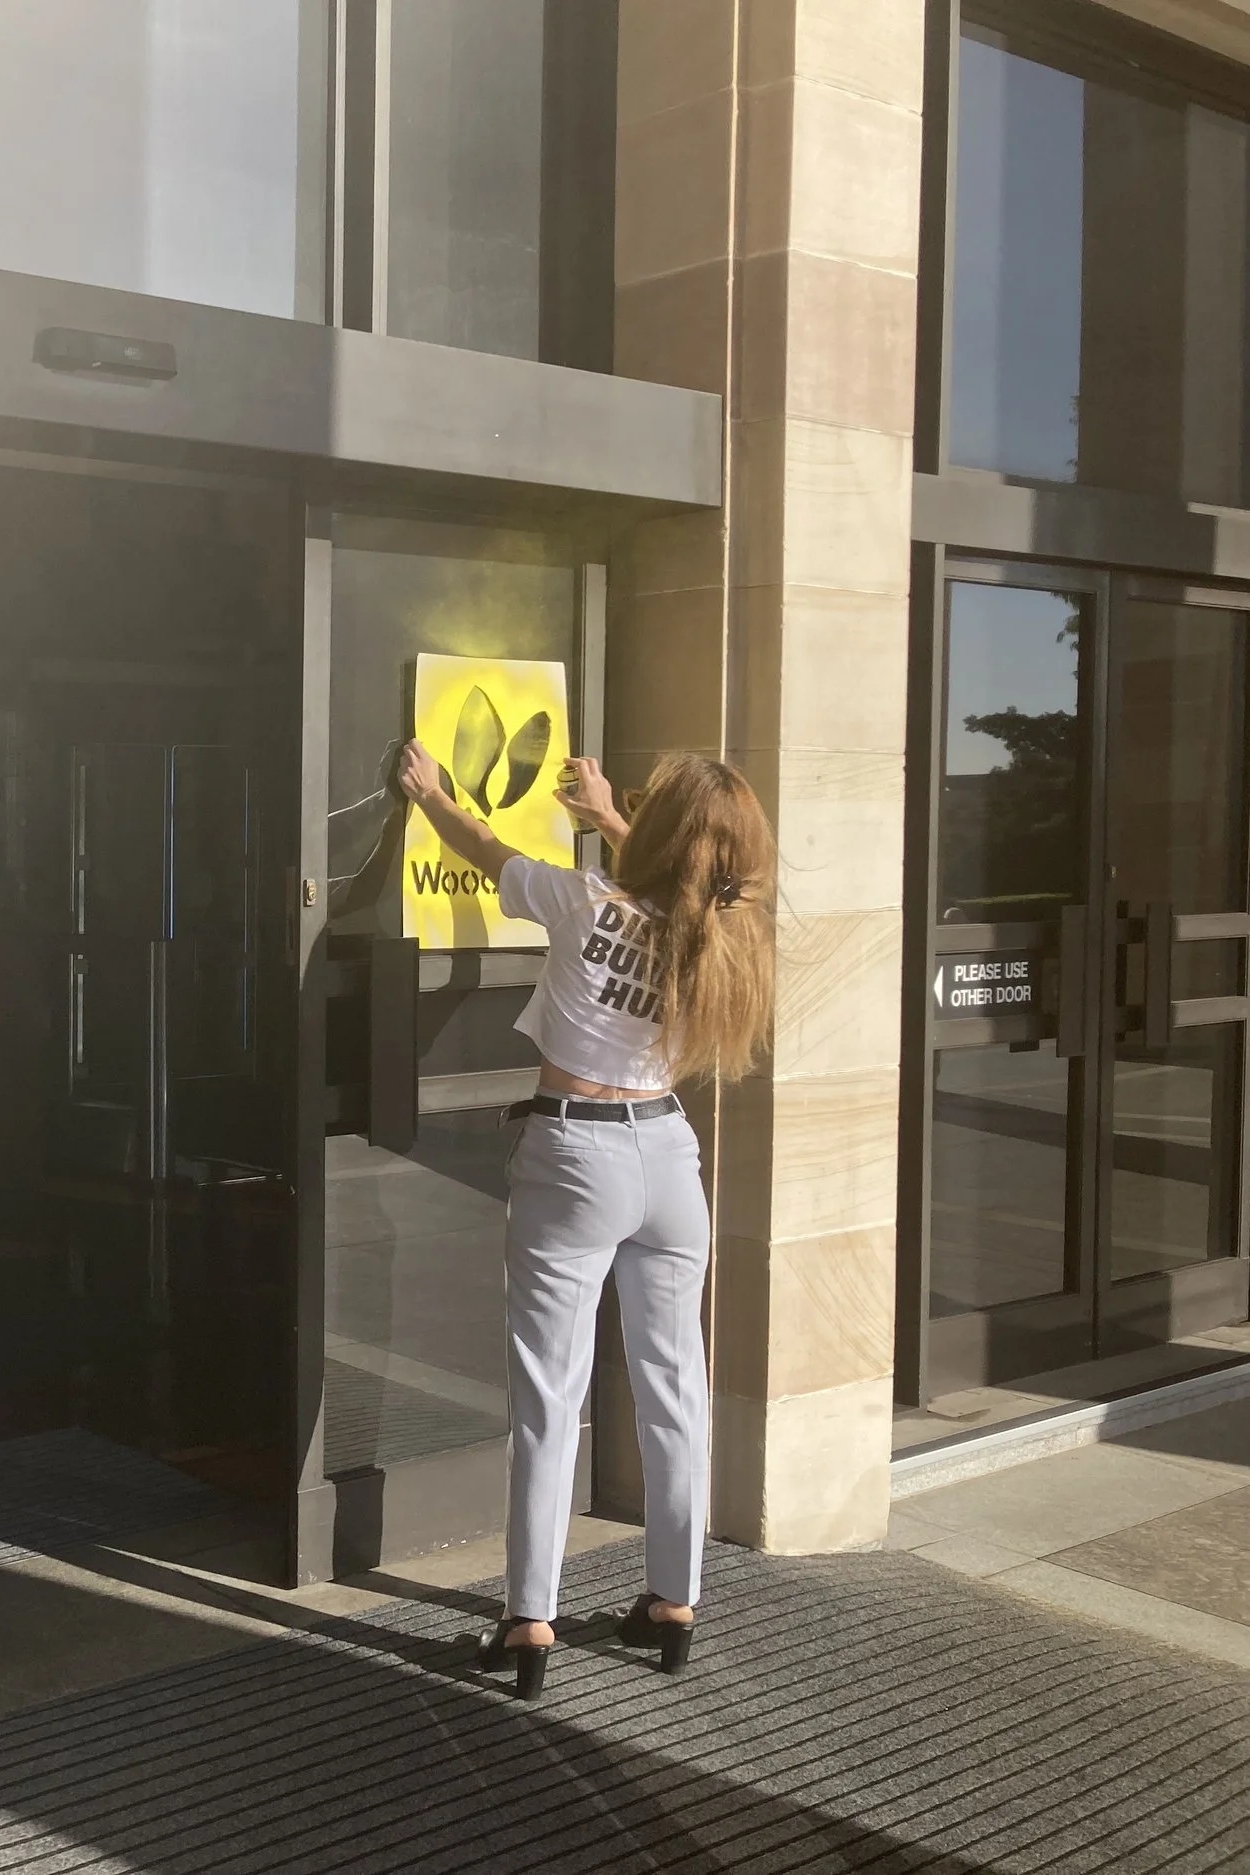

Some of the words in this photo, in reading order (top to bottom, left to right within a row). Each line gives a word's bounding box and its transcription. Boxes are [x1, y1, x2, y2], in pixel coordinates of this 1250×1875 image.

[954, 963, 1002, 982] PLEASE
[1005, 961, 1029, 979] USE
[951, 988, 993, 1007] OTHER
[996, 985, 1032, 1003] DOOR
